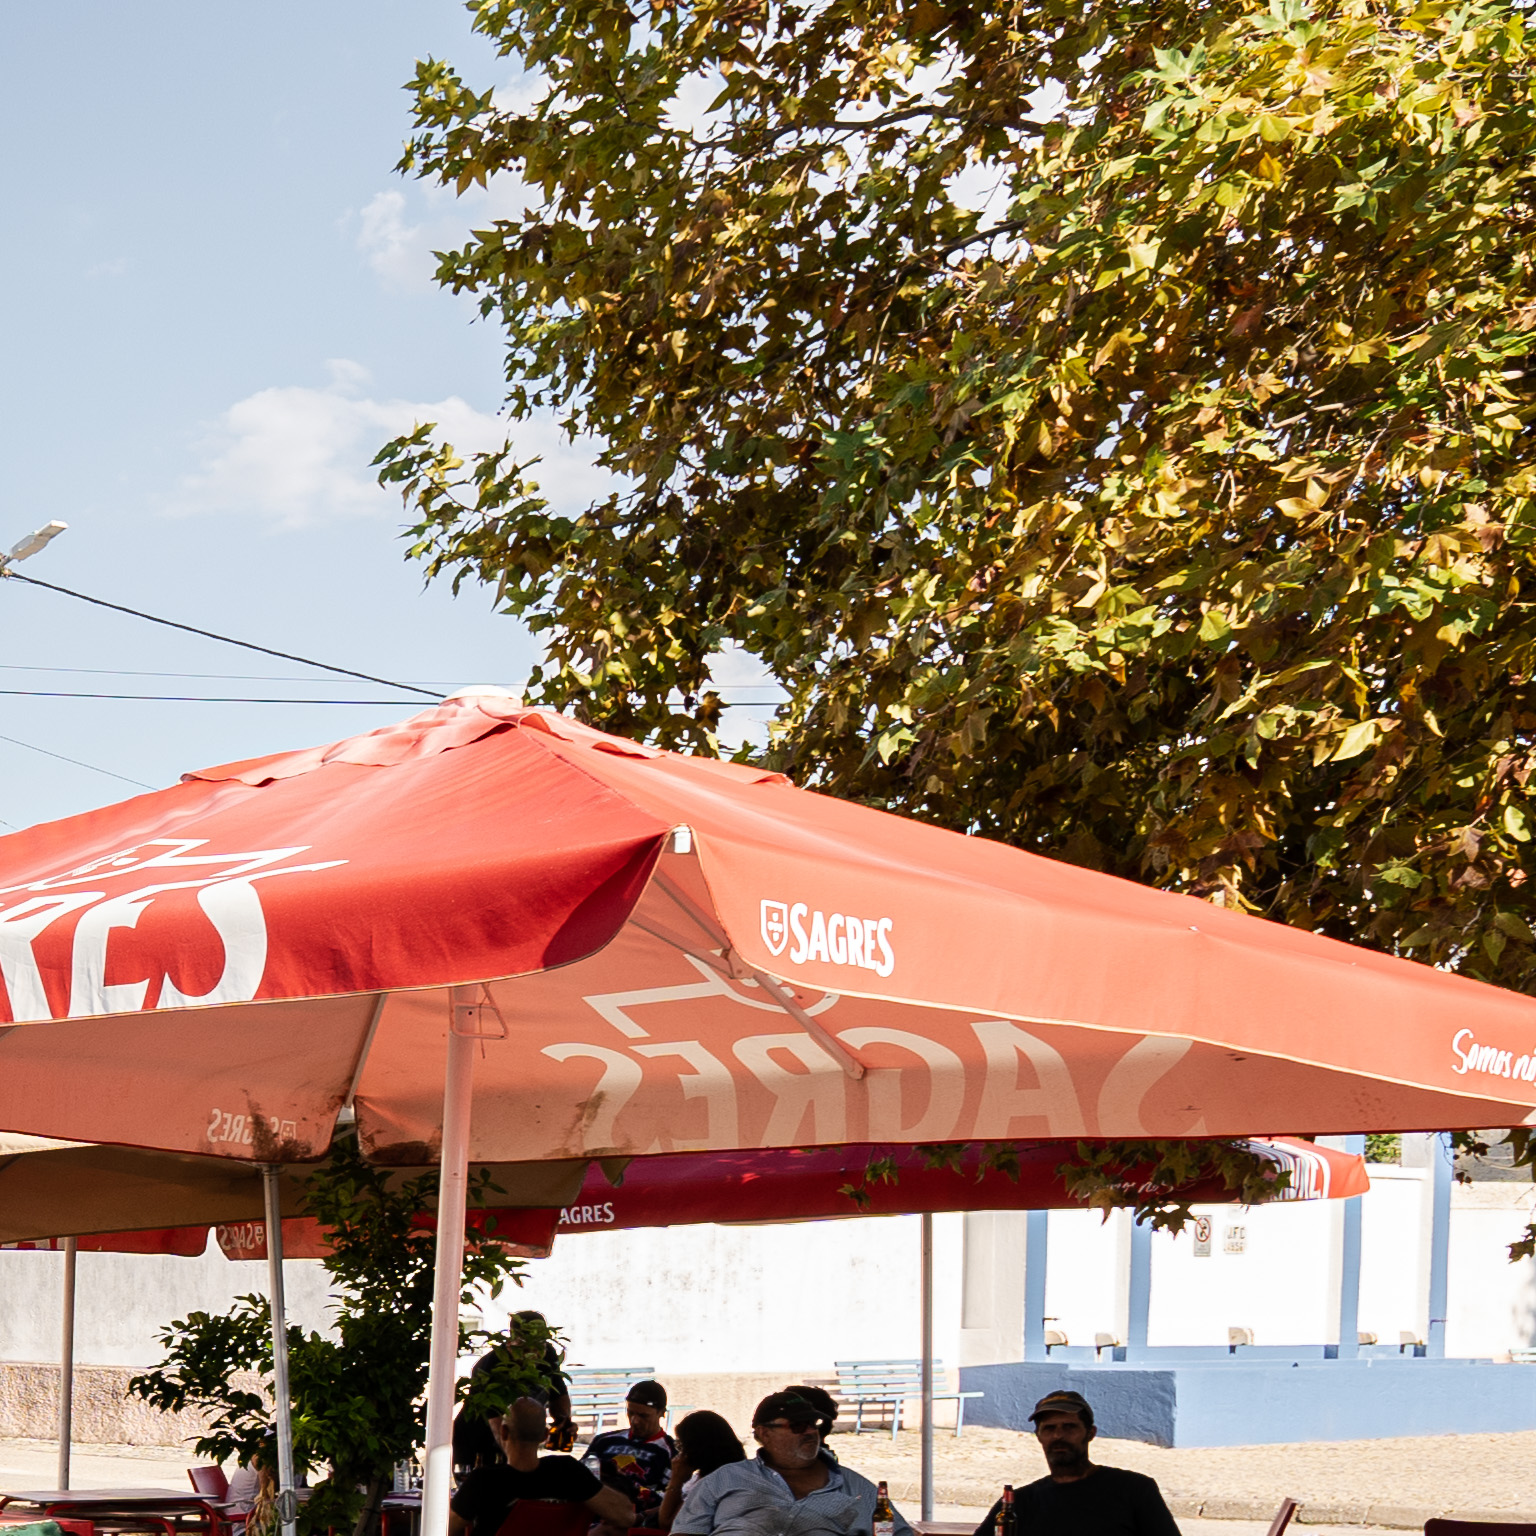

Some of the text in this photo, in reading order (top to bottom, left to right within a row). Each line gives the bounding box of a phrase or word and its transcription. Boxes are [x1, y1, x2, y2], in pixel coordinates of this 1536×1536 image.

[789, 903, 895, 977] SAGRES
[1451, 1028, 1514, 1078] Somos
[558, 1202, 616, 1224] AGRES
